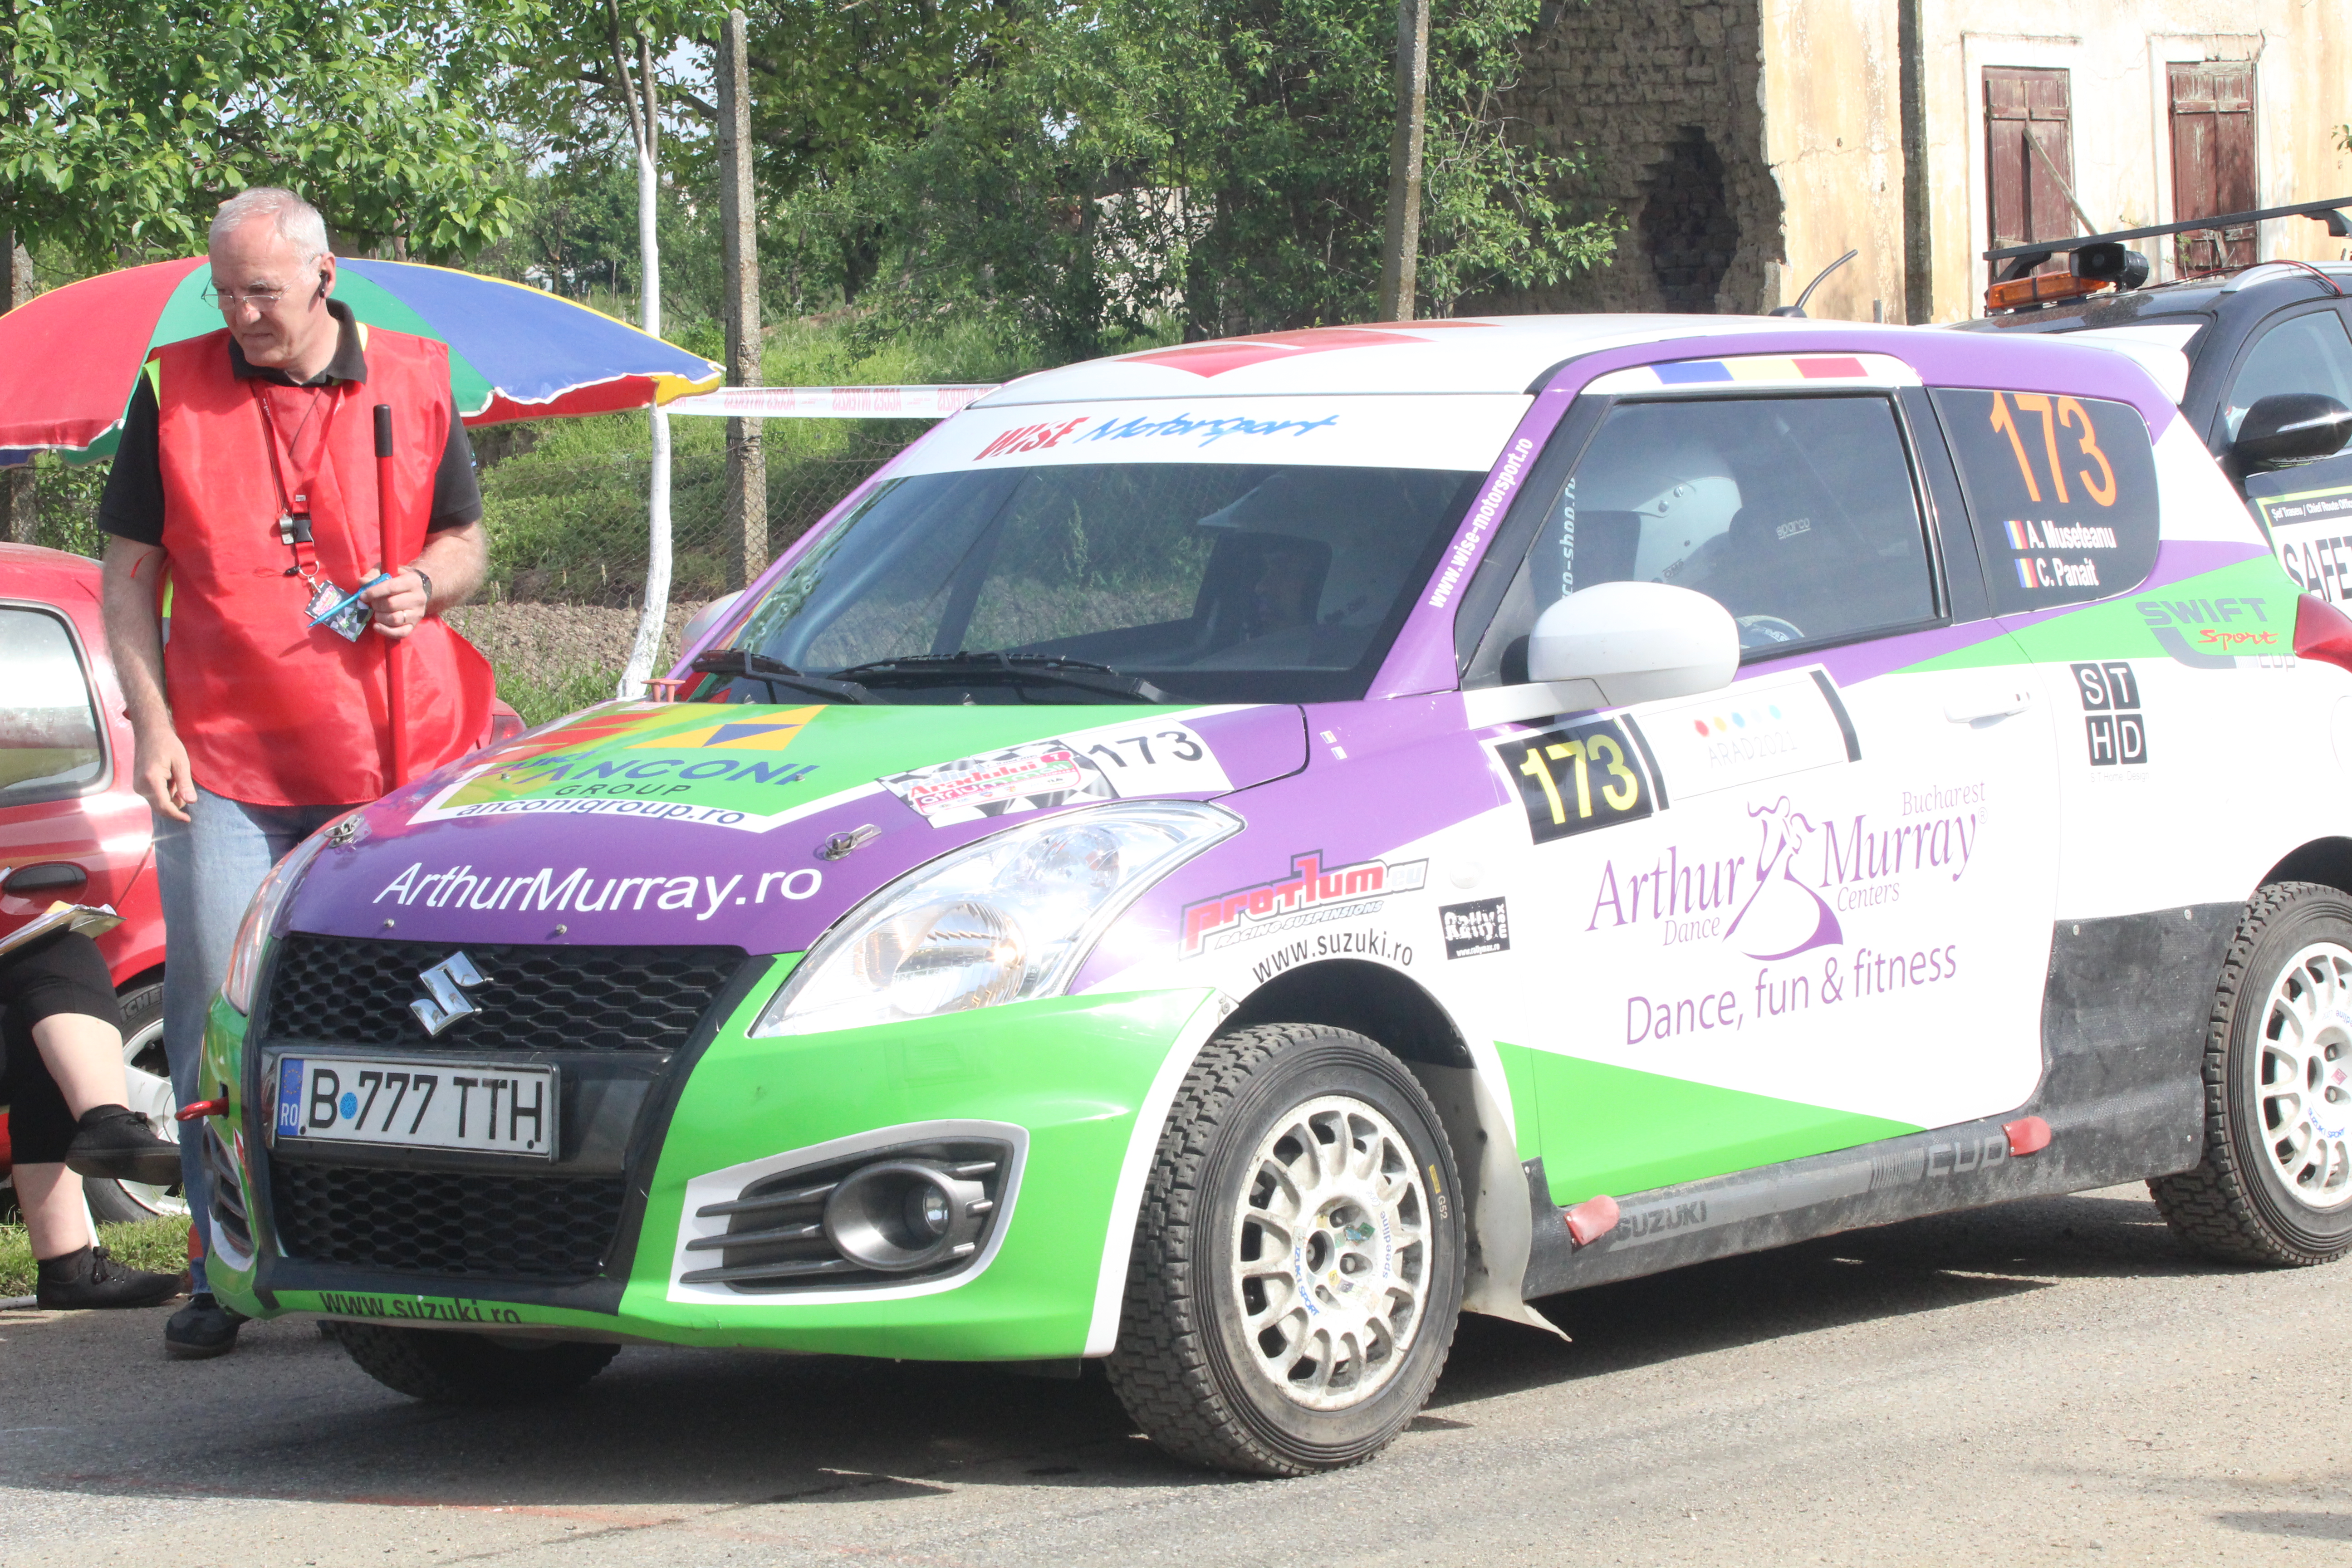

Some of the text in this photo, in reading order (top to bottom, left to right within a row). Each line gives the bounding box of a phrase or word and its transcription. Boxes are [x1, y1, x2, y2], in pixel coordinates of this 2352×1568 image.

[972, 416, 1091, 461] WISE
[1990, 391, 2117, 507] 173
[1428, 438, 1534, 609] www.wise-motorsport.ro
[2282, 506, 2303, 518] Traseu
[2306, 502, 2323, 514] Chief
[2321, 500, 2339, 512] Route
[2026, 520, 2117, 549] A. Museteanu
[2036, 558, 2100, 587] C. Panait
[2283, 536, 2352, 603] SAFE
[2135, 598, 2268, 626] SWIFT
[2198, 629, 2279, 651] Sport
[1088, 730, 1204, 768] 173
[1707, 732, 1798, 769] ARAD2021
[555, 784, 692, 796] GROUP
[911, 761, 1037, 798] Aradului
[921, 779, 1008, 805] atrium
[1011, 763, 1069, 782] mall
[1519, 734, 1639, 824] 173
[2127, 770, 2150, 783] Design
[456, 794, 745, 825] anconigroup.ro
[1901, 779, 1986, 816] Bucharest
[1584, 813, 1976, 931] Arthur Murray
[372, 862, 822, 921] ArthurMurray.ro
[1214, 900, 1384, 950] RACING SUSPENSIONS
[1663, 882, 1900, 946] Dance Centers
[1252, 928, 1413, 985] www.suzuki.ro
[1456, 943, 1501, 957] www.rallymax.ro
[1627, 944, 1957, 1045] Dance, fun & fitness
[280, 1102, 298, 1127] RO
[309, 1068, 543, 1142] B 777 TTH
[1438, 1195, 1448, 1220] G52
[1616, 1200, 1707, 1241] SUZUKI
[1380, 1210, 1392, 1279] speedline
[319, 1291, 522, 1323] www.suzukiro
[1298, 1285, 1320, 1316] SPORT
